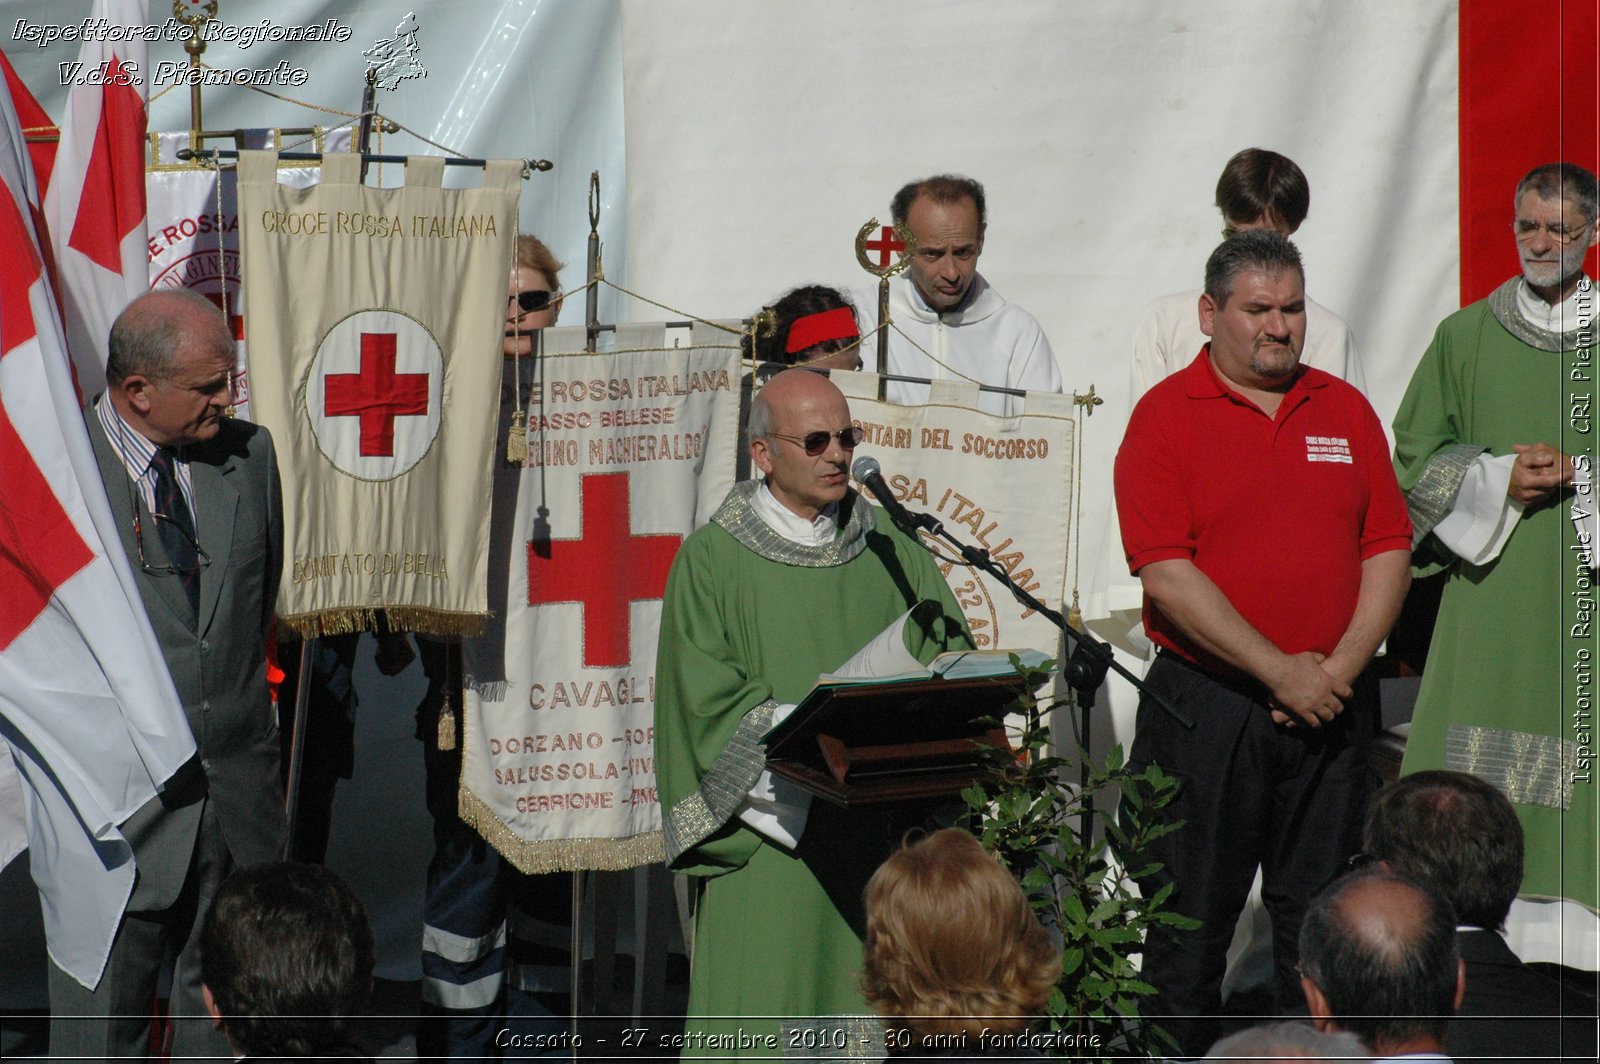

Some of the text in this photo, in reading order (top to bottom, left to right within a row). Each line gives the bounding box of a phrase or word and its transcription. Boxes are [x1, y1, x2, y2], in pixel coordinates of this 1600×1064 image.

[162, 214, 238, 246] ROSSA
[262, 210, 498, 240] CROCE ROSSA ITALIANA
[185, 254, 241, 280] GINEV
[551, 378, 633, 404] ROSSA
[529, 406, 677, 433] BASSO BIELLESE
[920, 427, 954, 451] DEL
[961, 432, 1049, 460] SOCCORSO
[293, 552, 449, 585] COMITATO DI BIELLA
[529, 676, 656, 710] CAVAGLI
[489, 731, 604, 756] DORZANO
[515, 791, 615, 815] CERRIONE
